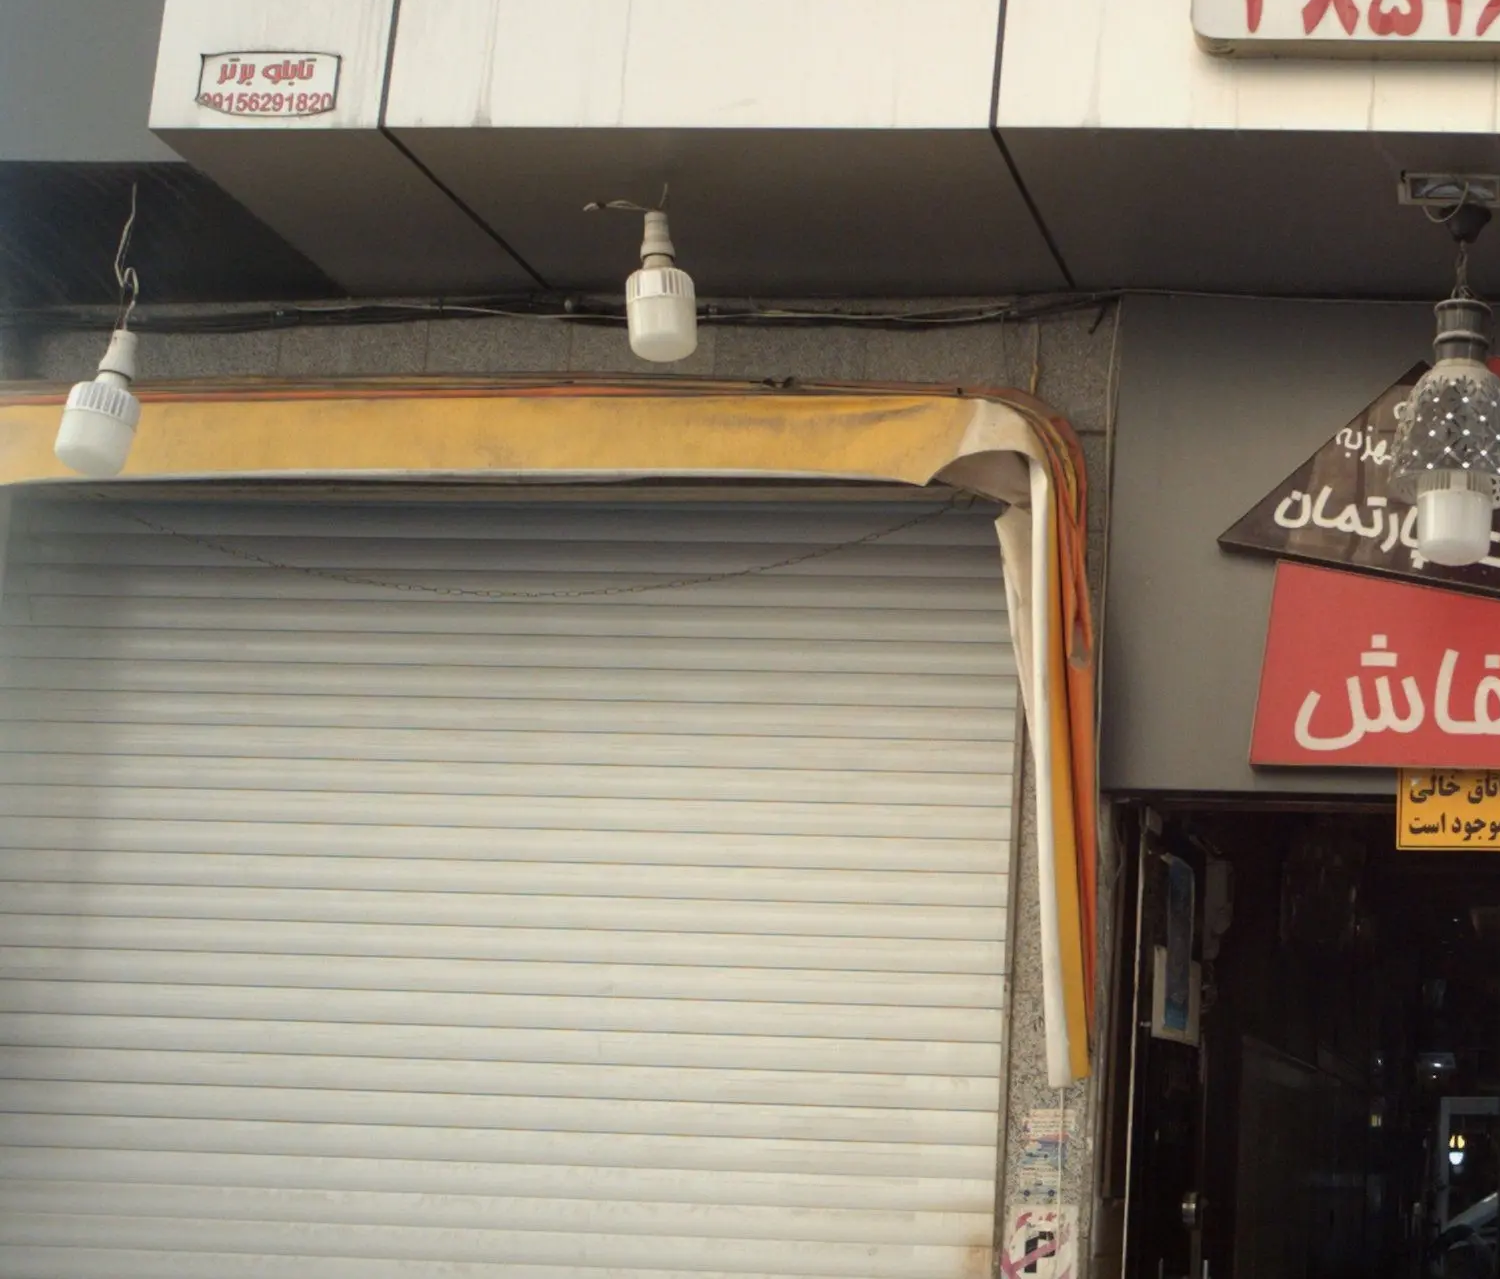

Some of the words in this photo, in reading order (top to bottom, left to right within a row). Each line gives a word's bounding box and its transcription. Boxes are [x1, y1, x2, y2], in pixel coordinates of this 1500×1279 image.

[216, 58, 256, 86] برتر
[1335, 426, 1362, 458] به
[1409, 770, 1461, 803] خالی
[1408, 811, 1446, 835] است
